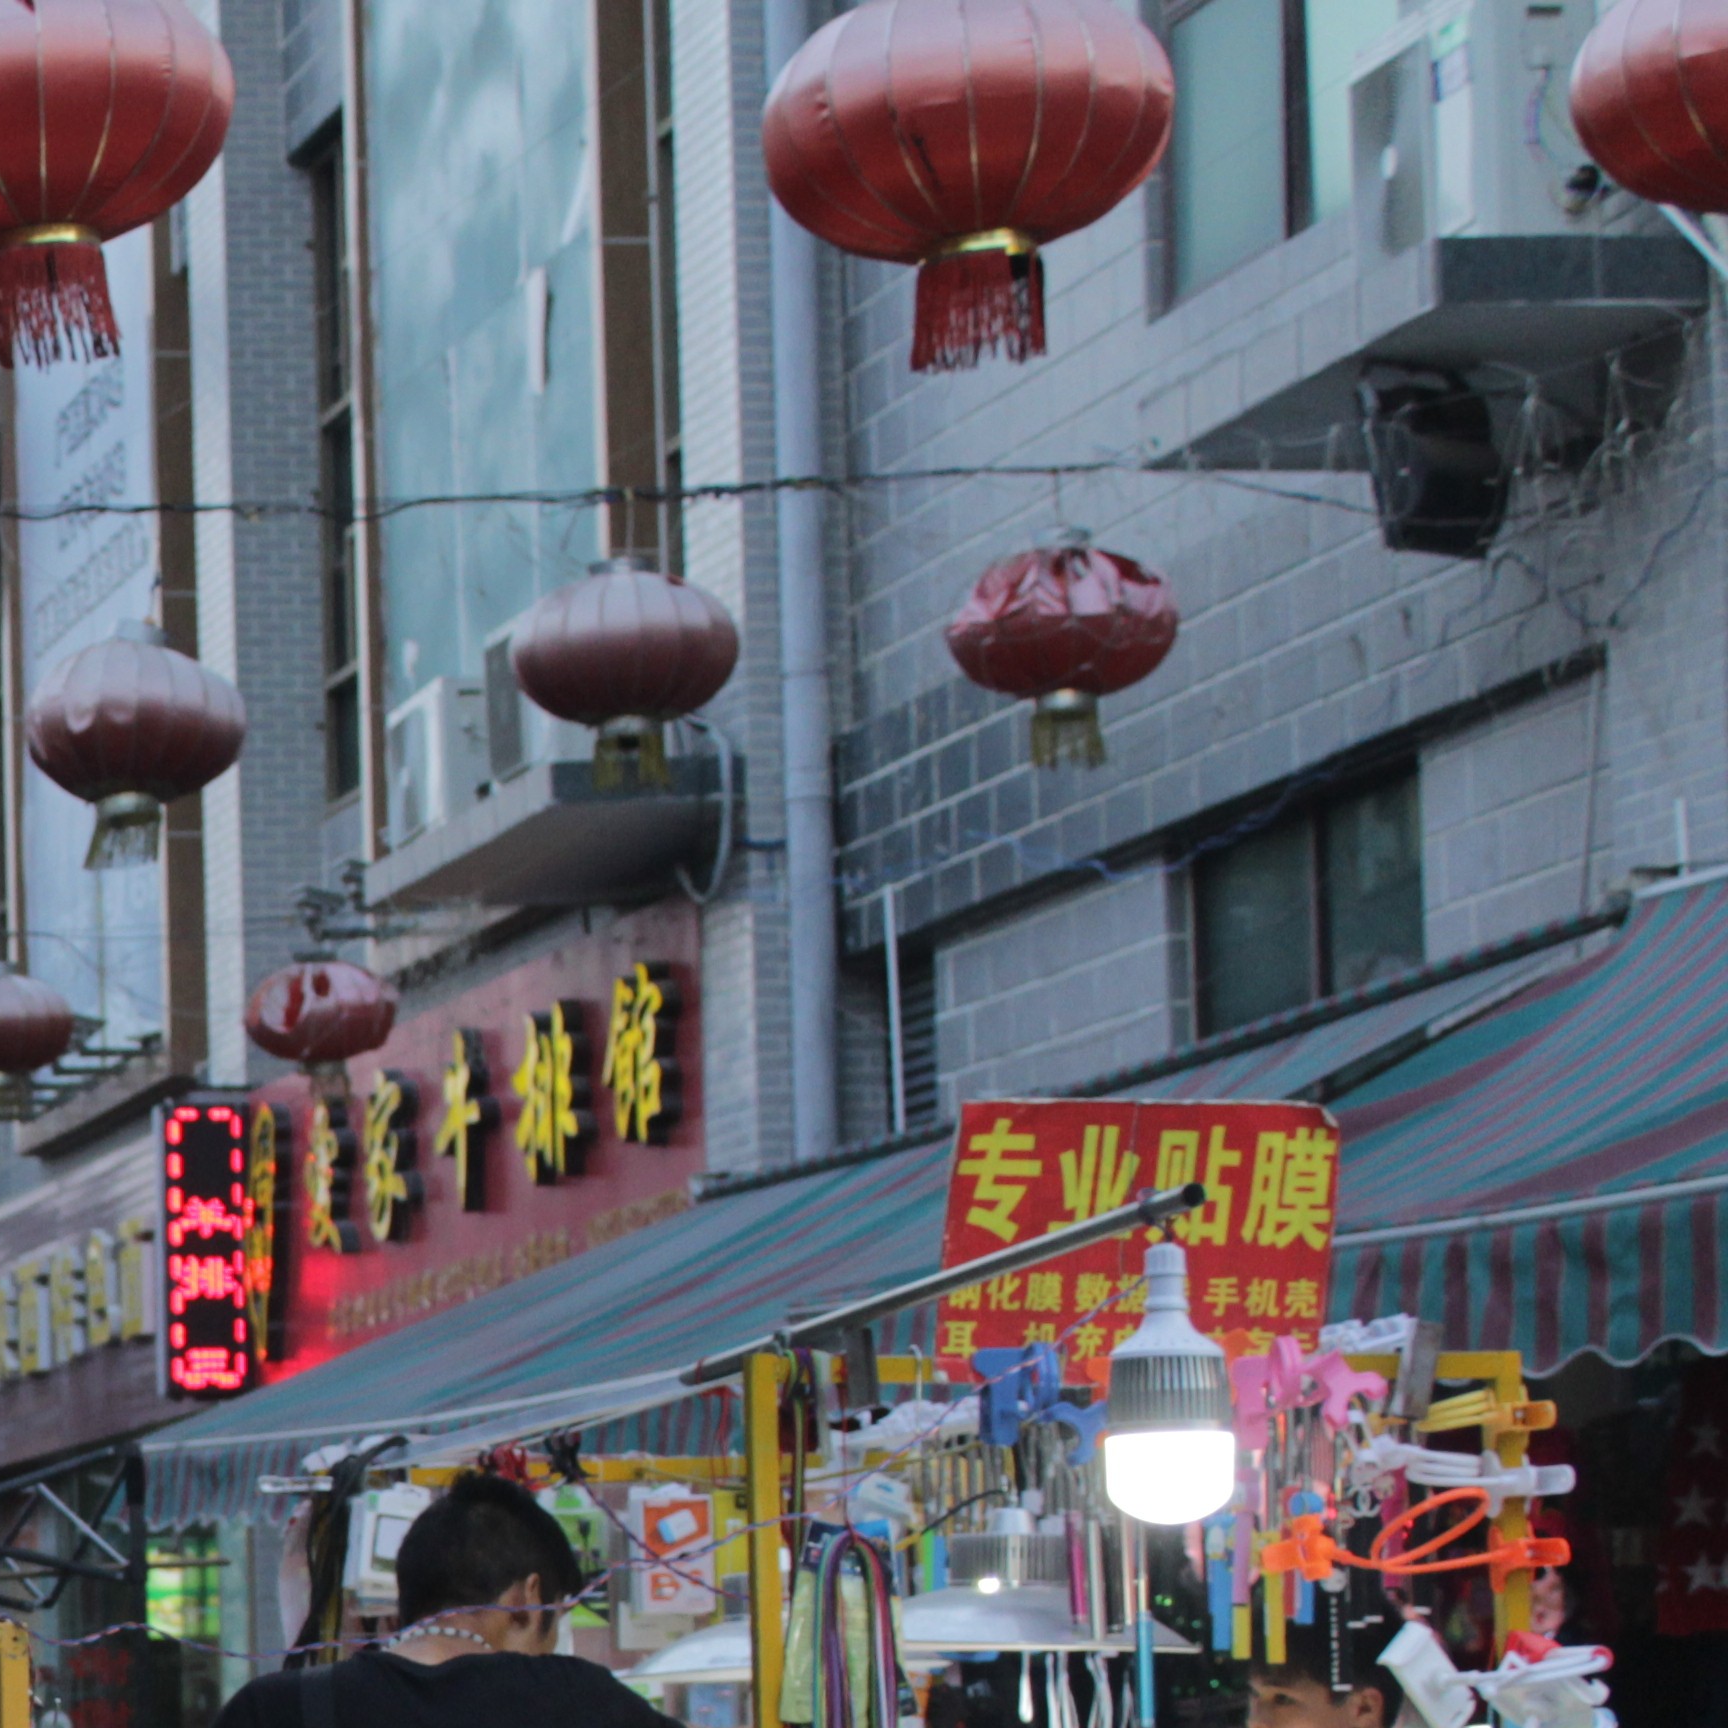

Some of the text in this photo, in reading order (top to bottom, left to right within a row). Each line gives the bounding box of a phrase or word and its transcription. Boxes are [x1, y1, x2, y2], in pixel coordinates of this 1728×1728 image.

[956, 1117, 1337, 1250] 专业贴膜
[1203, 1277, 1318, 1318] 手机壳
